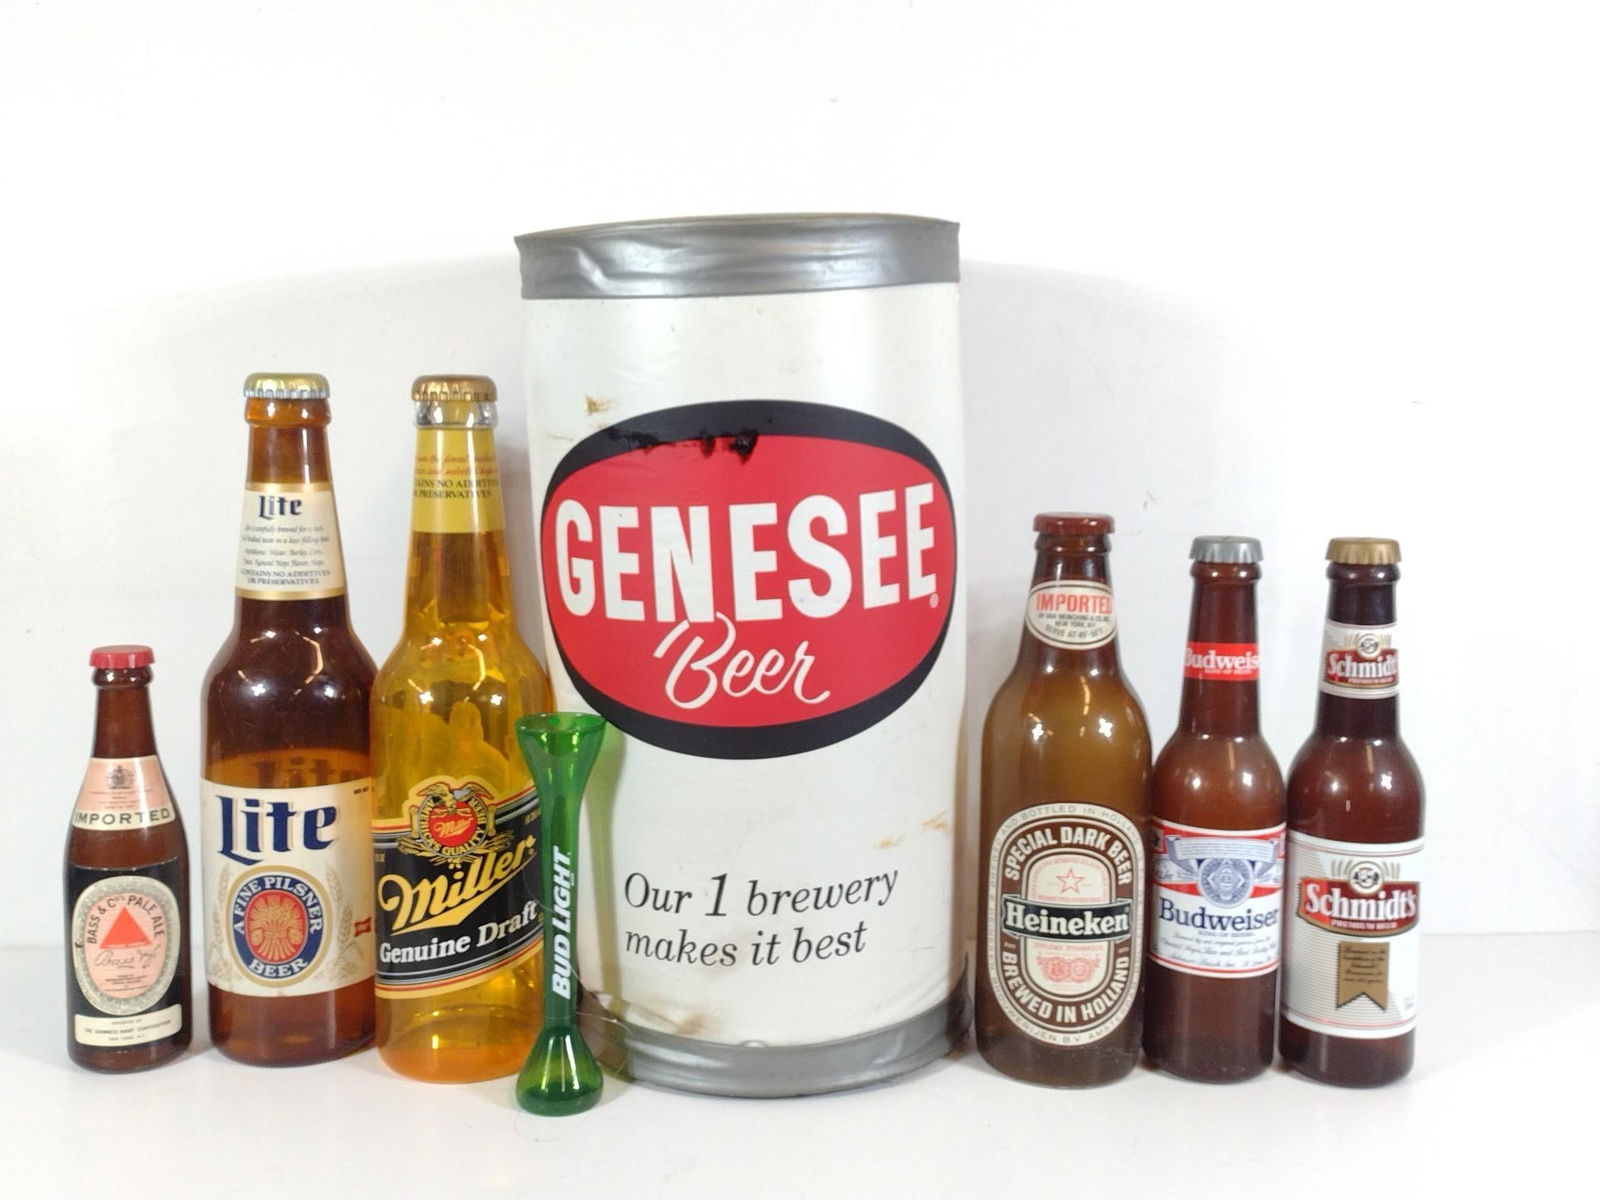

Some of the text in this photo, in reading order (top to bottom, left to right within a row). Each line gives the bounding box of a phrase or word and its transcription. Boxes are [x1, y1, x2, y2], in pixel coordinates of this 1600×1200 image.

[258, 495, 303, 520] Lite
[556, 482, 936, 623] GENESEE
[653, 611, 831, 709] Beer
[74, 807, 171, 825] IMPORTED
[216, 794, 340, 866] Lite
[1020, 803, 1078, 821] BOTTLED
[1005, 828, 1058, 881] SPECIAL
[1060, 826, 1111, 851] DARK
[1107, 840, 1133, 885] BEER
[236, 879, 263, 917] FINE
[264, 875, 324, 934] PILSNER
[378, 836, 537, 935] Miller
[624, 869, 899, 917] Our 1 brewery
[1305, 884, 1417, 921] Schmidt's
[87, 914, 101, 945] BASS
[127, 895, 157, 915] PALE
[151, 916, 165, 939] ALE
[233, 922, 246, 935] A
[380, 900, 539, 964] Genuine Draft
[552, 845, 571, 1000] BUD LIGHT
[1005, 900, 1129, 936] Heineken
[1159, 897, 1279, 932] Budweiser
[249, 957, 309, 978] BEER
[625, 921, 868, 967] makes it best
[1002, 951, 1130, 1023] BREWED IN HOLLAND
